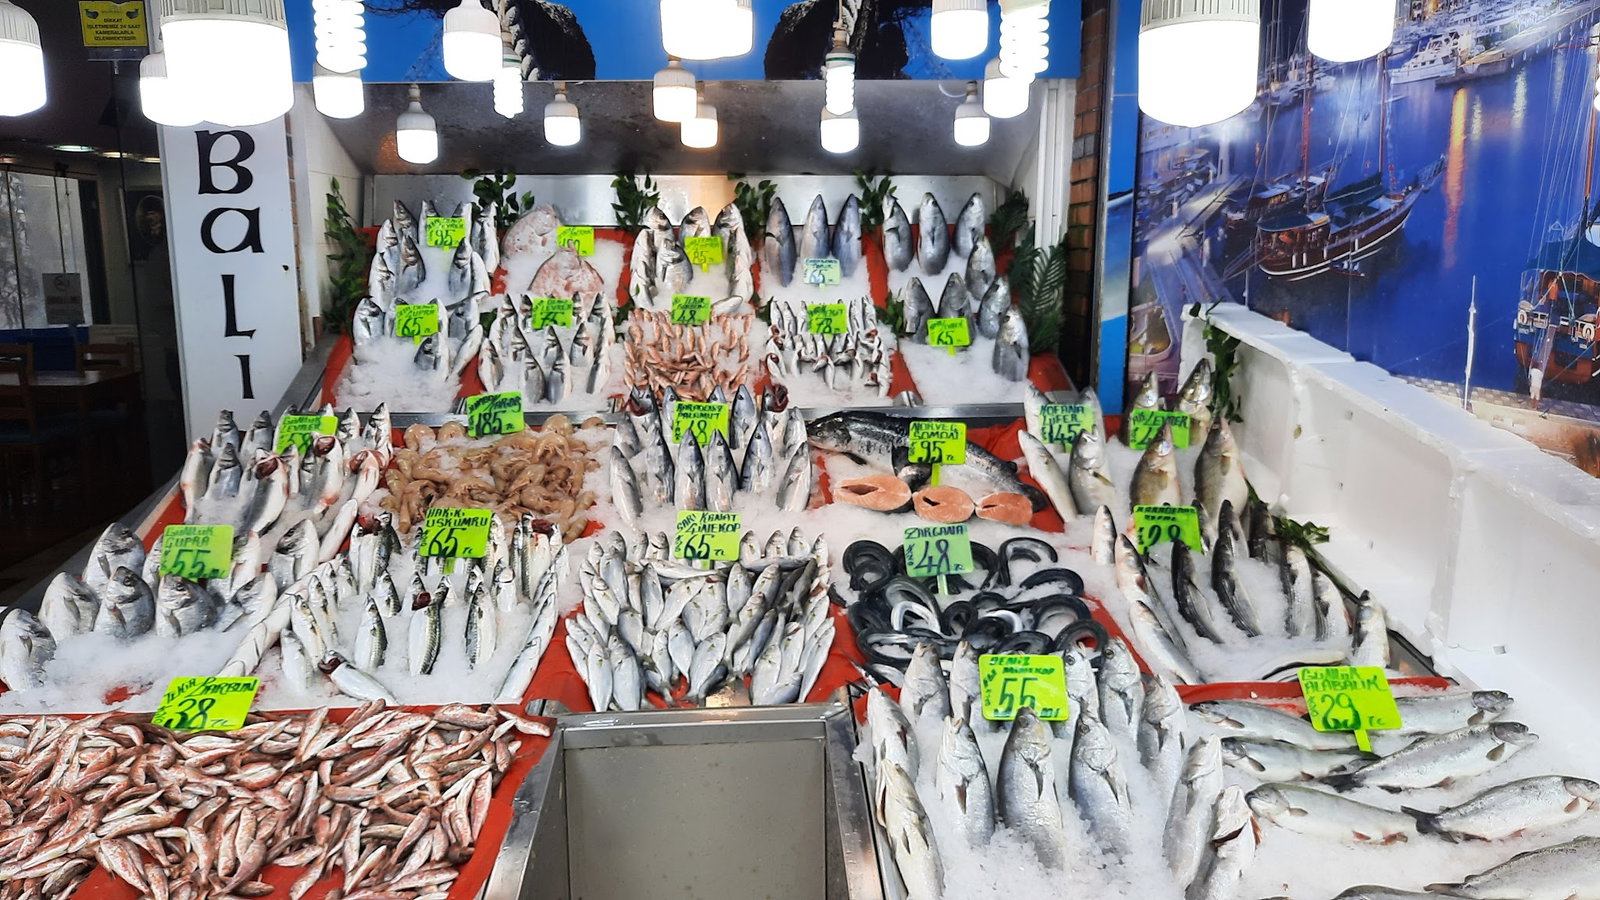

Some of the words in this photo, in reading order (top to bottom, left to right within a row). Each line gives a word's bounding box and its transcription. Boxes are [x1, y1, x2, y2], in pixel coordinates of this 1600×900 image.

[435, 230, 455, 246] 95
[402, 316, 423, 337] 65
[815, 317, 832, 334] 78
[937, 330, 954, 345] 65
[476, 410, 506, 436] 185
[1048, 423, 1081, 443] 145
[917, 440, 946, 463] 95
[426, 517, 489, 528] USKUMRU
[700, 512, 737, 523] KANAT
[428, 527, 467, 557] 65
[904, 525, 963, 539] ZARGANA
[684, 534, 715, 559] 65
[913, 538, 950, 574] 48
[169, 549, 211, 577] 55
[994, 677, 1038, 717] 55
[1321, 692, 1361, 730] 29
